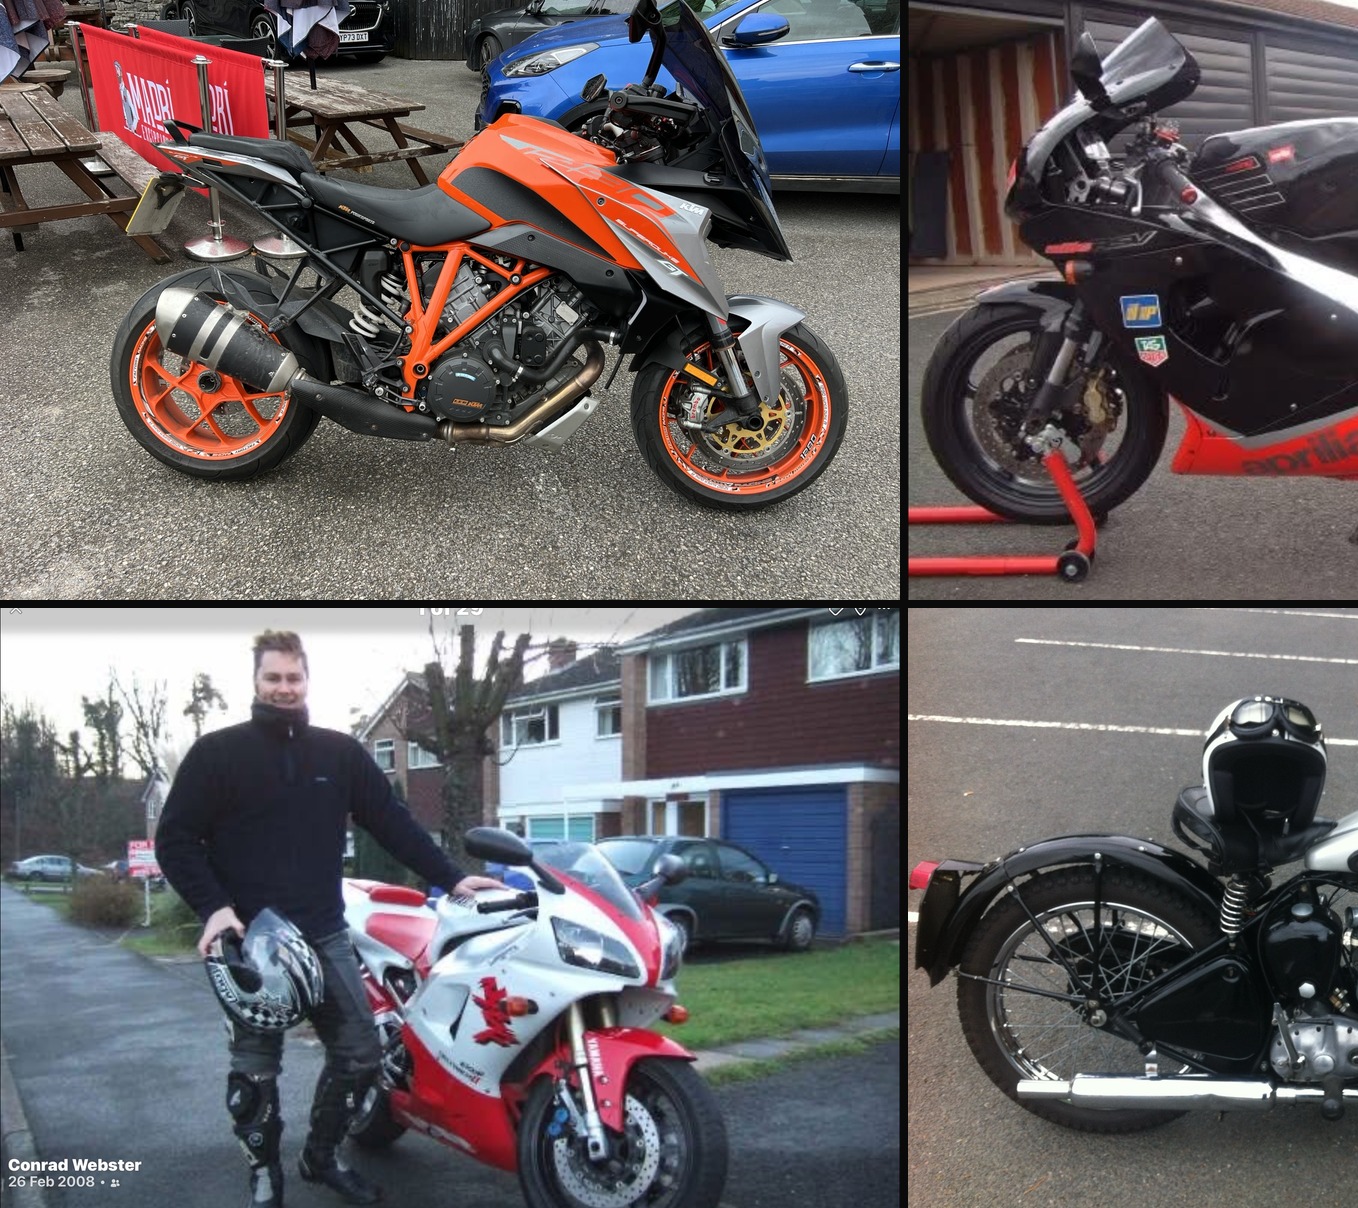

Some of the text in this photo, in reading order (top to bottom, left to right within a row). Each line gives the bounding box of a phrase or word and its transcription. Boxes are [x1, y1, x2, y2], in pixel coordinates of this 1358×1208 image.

[679, 202, 706, 216] KTM
[657, 259, 690, 277] GT
[689, 397, 702, 420] brembo
[587, 1037, 604, 1078] YAMAHA
